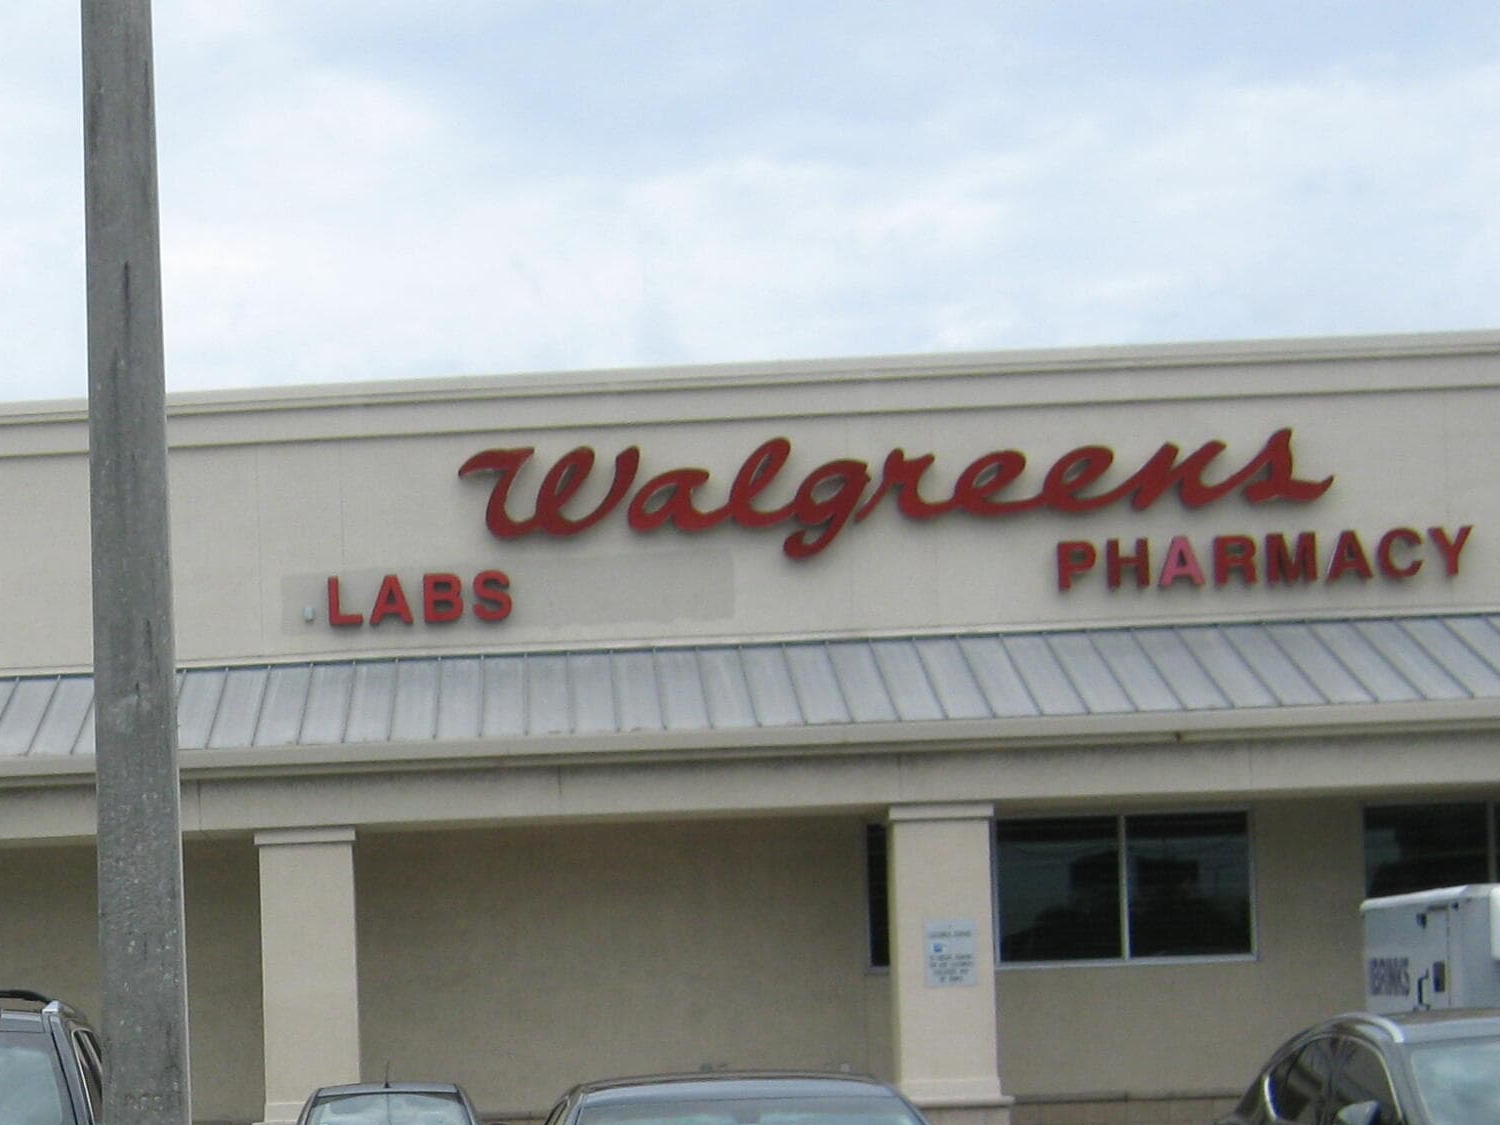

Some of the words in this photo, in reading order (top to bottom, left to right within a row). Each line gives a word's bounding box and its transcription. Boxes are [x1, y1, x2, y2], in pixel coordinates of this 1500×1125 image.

[458, 428, 1335, 560] Walgreens
[1057, 526, 1471, 592] PHARMACY
[326, 569, 515, 627] LABS
